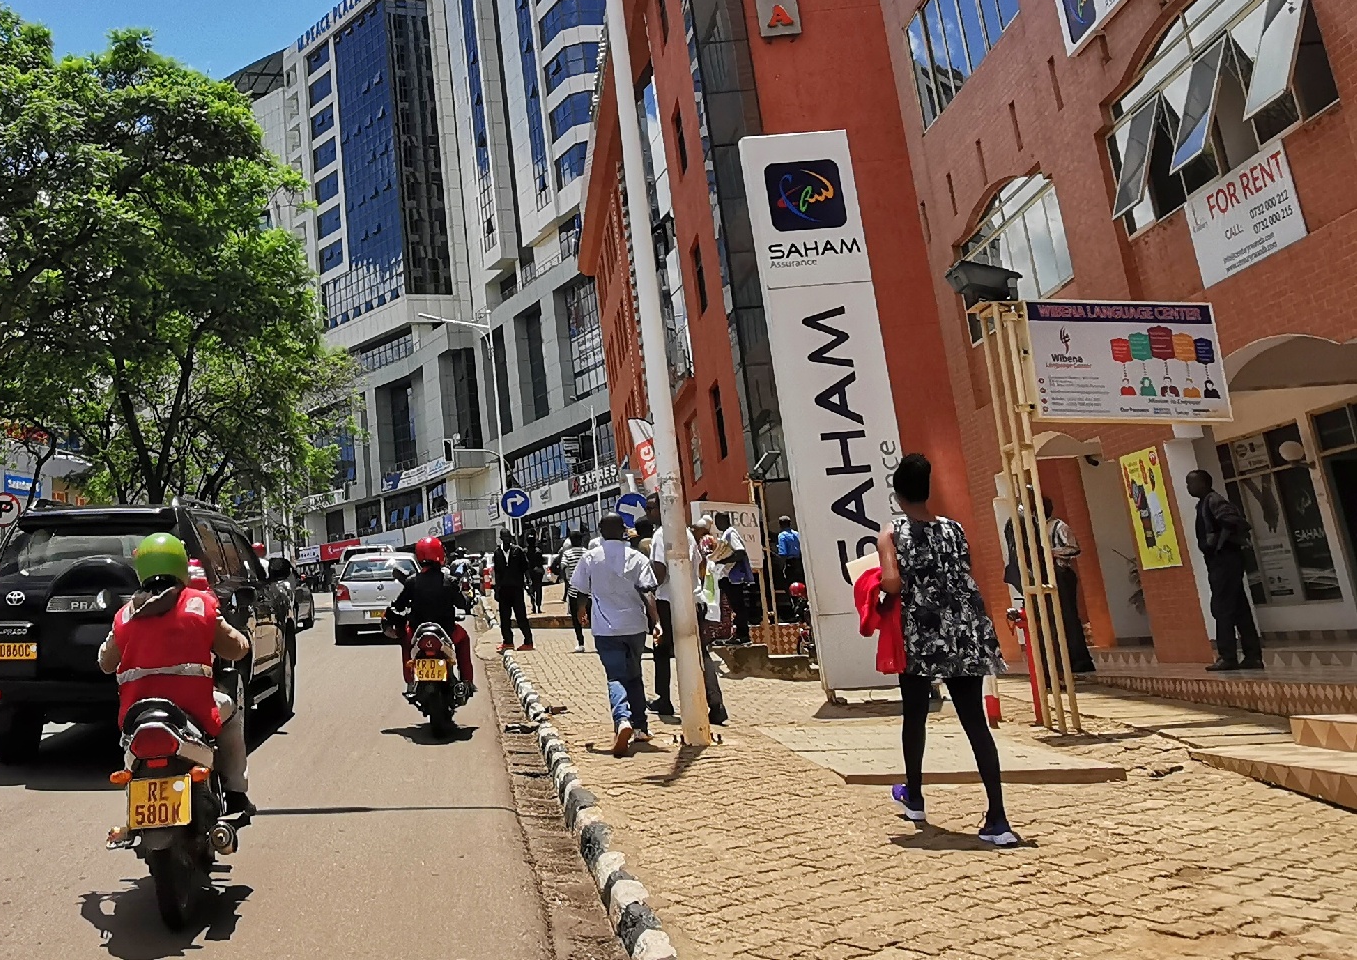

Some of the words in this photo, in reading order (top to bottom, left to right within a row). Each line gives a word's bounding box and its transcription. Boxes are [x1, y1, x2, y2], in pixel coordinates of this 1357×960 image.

[1206, 181, 1241, 220] FOR
[1239, 149, 1284, 200] RENT
[1249, 203, 1266, 219] 0732
[1252, 217, 1270, 235] 0732
[1279, 204, 1294, 220] 215
[768, 237, 861, 260] SAHAM
[770, 259, 818, 269] Assurance
[1037, 304, 1086, 319] WIBENA
[1087, 305, 1154, 321] LANGUAGE
[1154, 306, 1202, 322] CENTER
[1050, 353, 1084, 363] Wibena
[579, 464, 617, 486] EXPRES
[70, 601, 102, 610] PRA
[148, 781, 170, 802] RE
